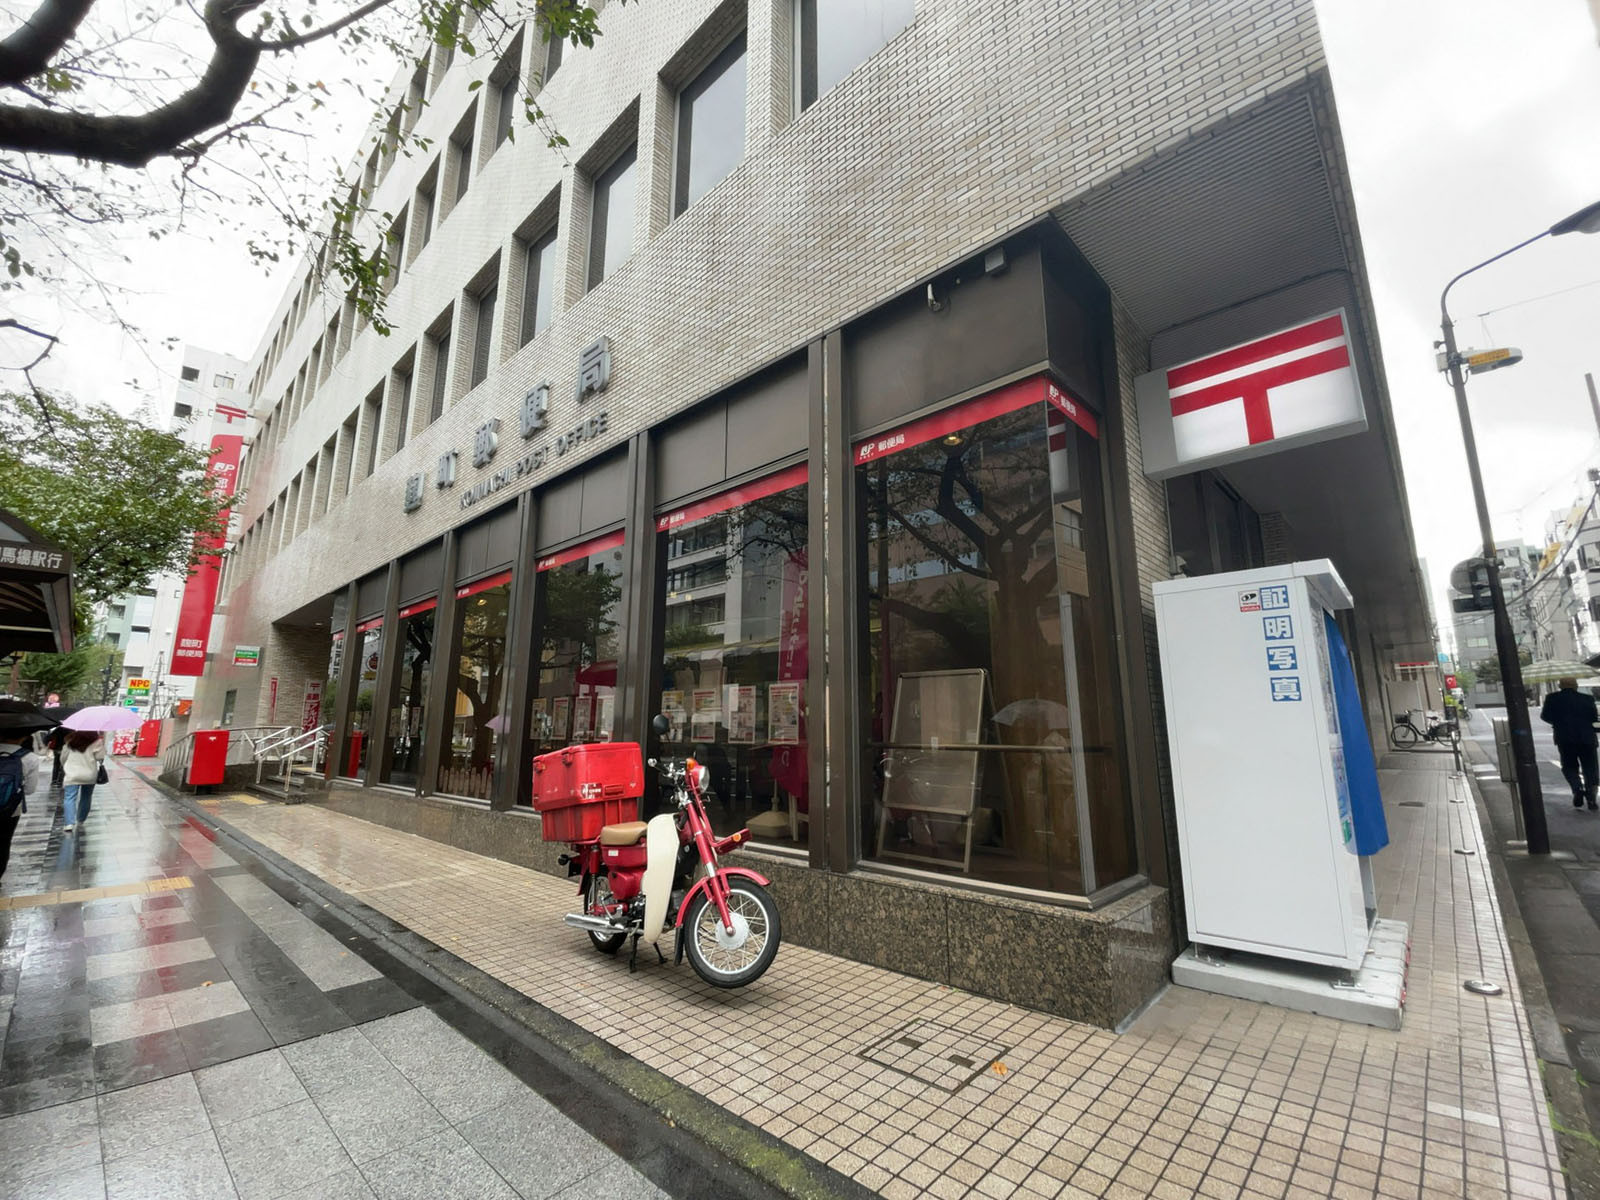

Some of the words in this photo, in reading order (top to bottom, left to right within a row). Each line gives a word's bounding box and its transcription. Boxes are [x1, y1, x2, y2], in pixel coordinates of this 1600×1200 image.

[517, 446, 549, 478] POST
[556, 410, 608, 455] OFFICE
[878, 434, 905, 452] 郵便局
[0, 547, 63, 568] 馬場駅行
[1260, 586, 1301, 701] 証明写真
[130, 679, 150, 688] NPC
